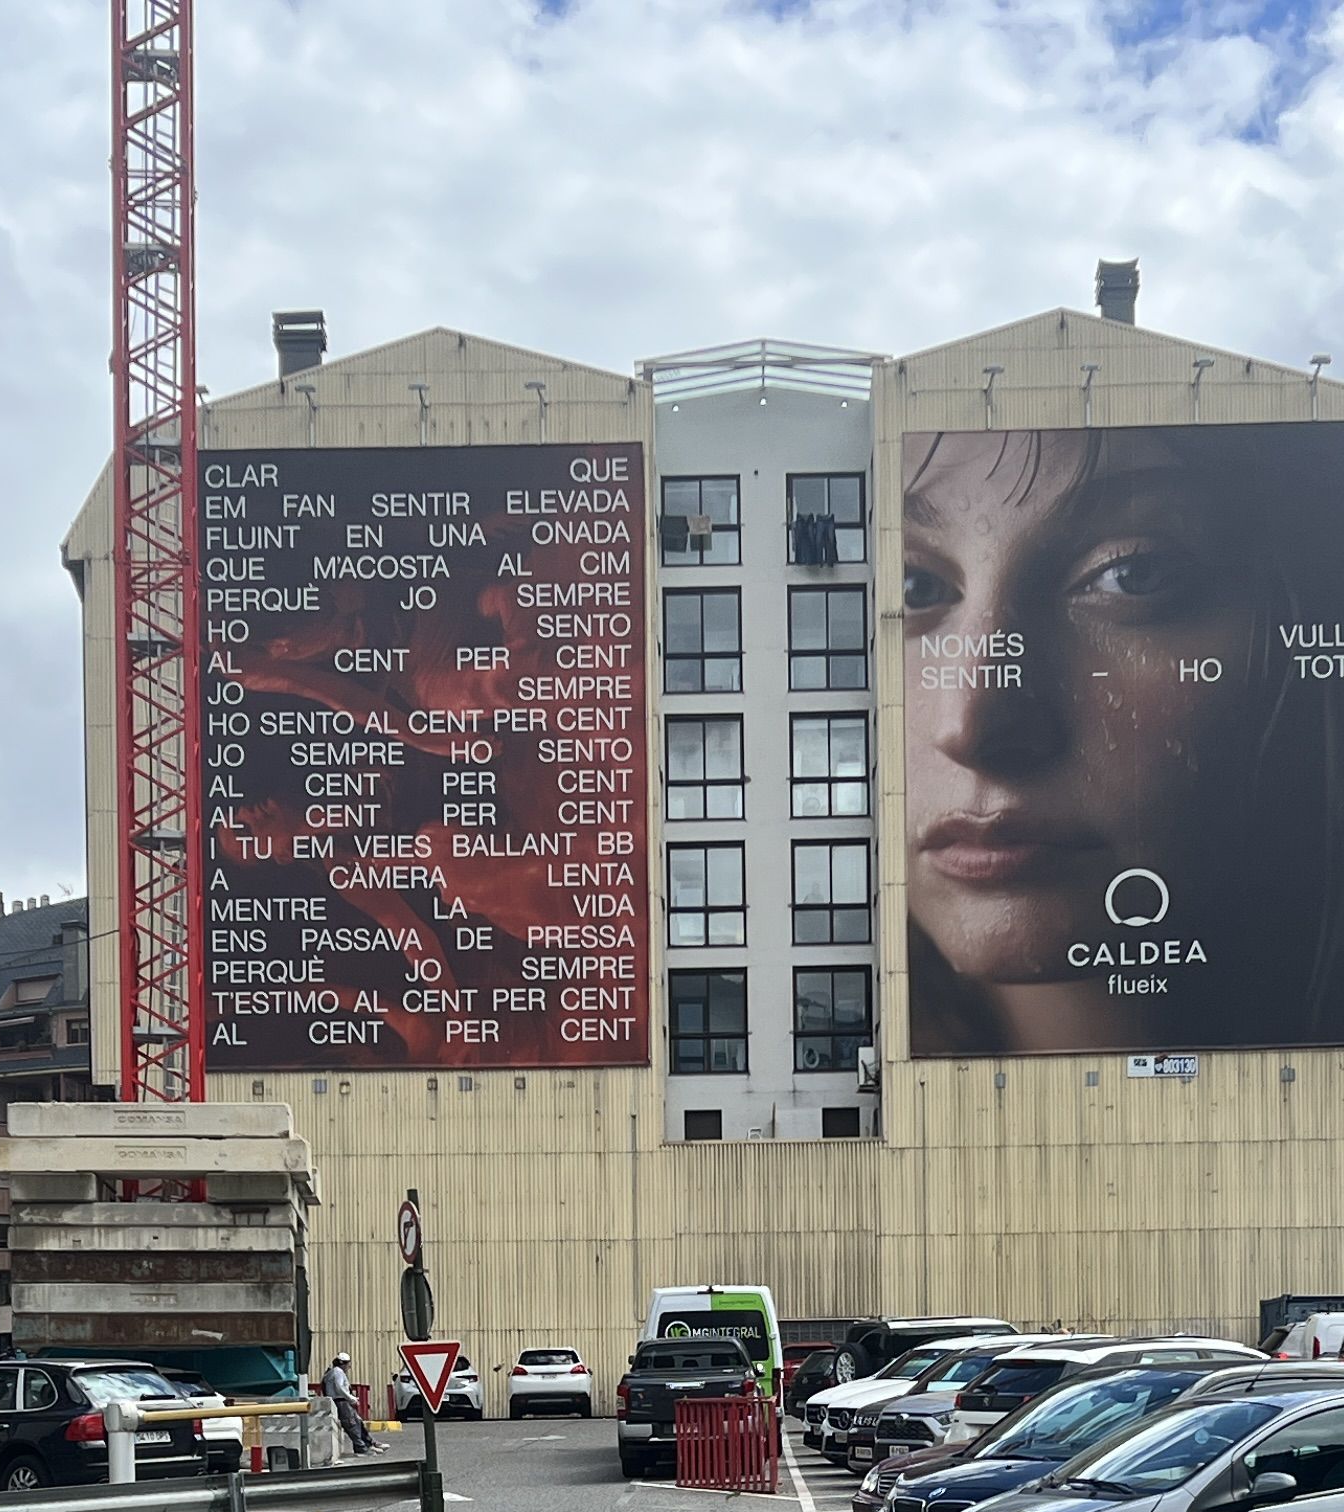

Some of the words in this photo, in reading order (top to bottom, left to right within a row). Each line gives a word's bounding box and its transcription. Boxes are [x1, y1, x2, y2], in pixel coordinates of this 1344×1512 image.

[204, 463, 279, 489] CLAR
[569, 456, 629, 484] QUE
[205, 495, 246, 520] EM
[283, 493, 335, 518] FAN
[371, 491, 471, 518] SENTIR
[506, 487, 631, 515] ELEVADA
[206, 524, 301, 551] FLUINT
[346, 523, 383, 548] EN
[428, 521, 487, 548] UNA
[531, 519, 631, 546] ONADA
[205, 556, 266, 583] QUE
[313, 554, 451, 580] M'ACOSTA
[497, 552, 533, 577] AL
[579, 549, 630, 576] CIM
[206, 582, 321, 613] PERQUÈ
[399, 585, 437, 611] JO
[516, 581, 631, 608] SEMPRE
[207, 618, 250, 644] HO
[536, 612, 632, 639] SENTO
[921, 628, 1025, 659] NOMÉS
[207, 650, 243, 675] AL
[334, 648, 411, 673] CENT
[456, 646, 510, 672] PER
[556, 643, 633, 670] CENT
[921, 664, 1022, 689] SENTIR
[1178, 657, 1223, 683] HO
[207, 680, 245, 706] JO
[517, 674, 633, 701] SEMPRE
[208, 711, 251, 737] HO
[259, 709, 355, 736] SENTO
[363, 710, 400, 735] AL
[407, 708, 485, 735] CENT
[493, 707, 548, 733] PER
[556, 706, 633, 732] CENT
[207, 743, 245, 768] JO
[290, 741, 405, 766] SEMPRE
[450, 739, 493, 765] HO
[537, 736, 633, 763] SENTO
[208, 774, 244, 799] AL
[304, 772, 381, 797] CENT
[442, 771, 496, 796] PER
[557, 768, 634, 794] CENT
[209, 805, 245, 829] AL
[305, 803, 382, 828] CENT
[443, 802, 497, 827] PER
[557, 799, 634, 825] CENT
[210, 836, 216, 860] I
[235, 835, 273, 860] TU
[292, 835, 334, 859] EM
[353, 834, 433, 859] VEIES
[452, 831, 578, 858] BALLANT
[597, 830, 635, 856] BB
[209, 867, 230, 892] A
[329, 861, 448, 890] CÀMERA
[547, 861, 635, 887] LENTA
[211, 897, 327, 922] MENTRE
[433, 895, 468, 920] LA
[572, 892, 636, 918] VIDA
[211, 928, 267, 953] ENS
[301, 927, 423, 952] PASSAVA
[456, 926, 494, 951] DE
[527, 924, 636, 949] PRESSA
[1067, 939, 1207, 967] CALDEA
[212, 954, 326, 985] PERQUÈ
[404, 957, 442, 983] JO
[521, 955, 636, 981] SEMPRE
[1107, 974, 1168, 995] flueix
[211, 989, 340, 1015] T'ESTIMO
[353, 989, 389, 1014] AL
[402, 988, 479, 1013] CENT
[492, 987, 546, 1012] PER
[560, 986, 636, 1011] CENT
[212, 1022, 248, 1046] AL
[308, 1020, 385, 1045] CENT
[446, 1019, 500, 1043] PER
[560, 1017, 637, 1042] CENT
